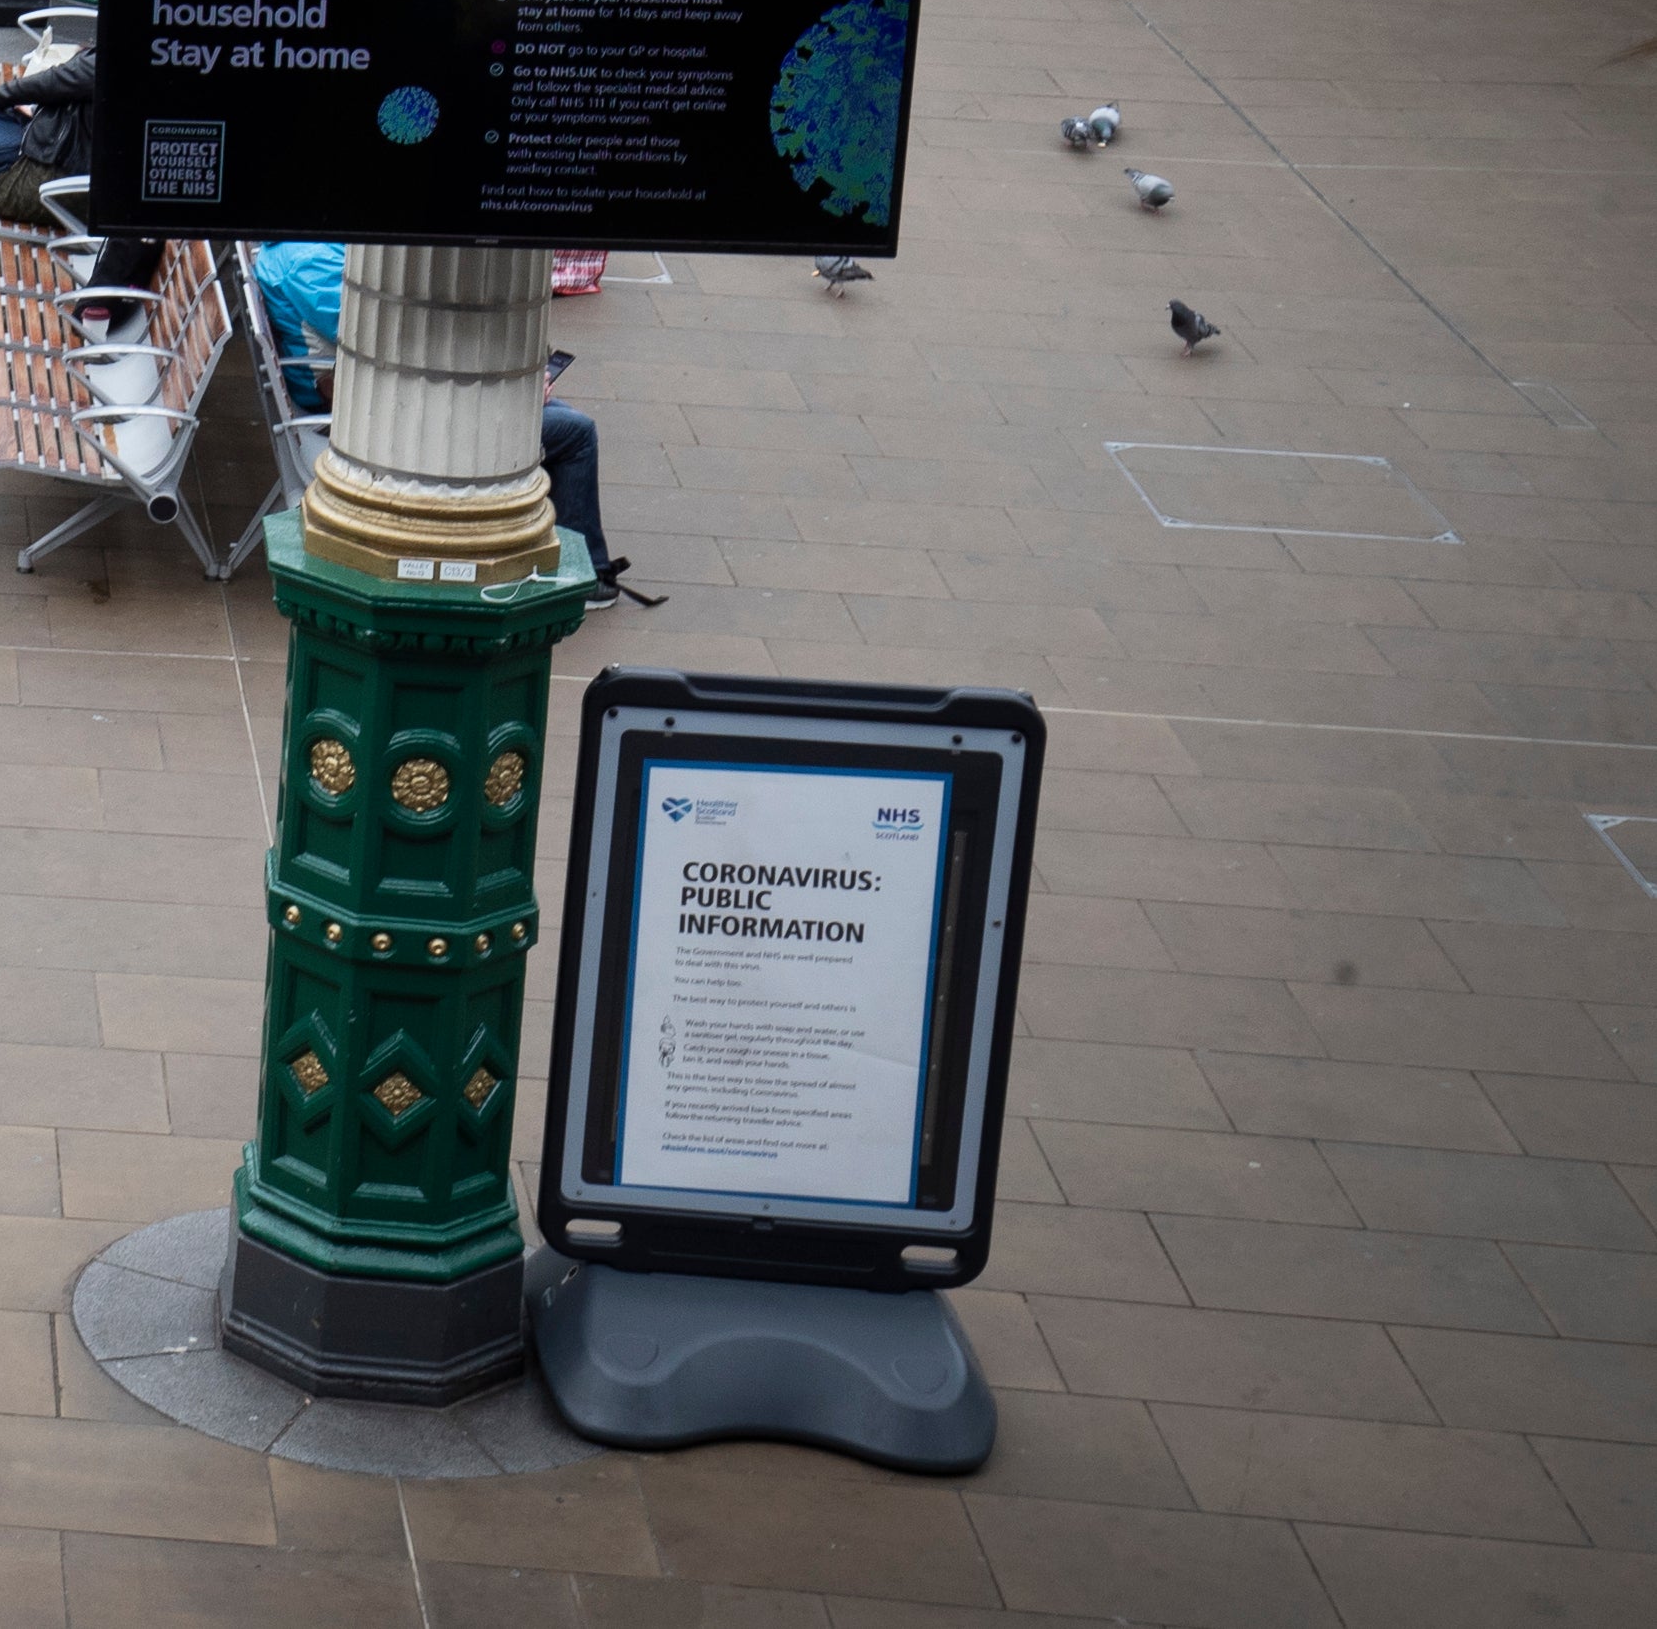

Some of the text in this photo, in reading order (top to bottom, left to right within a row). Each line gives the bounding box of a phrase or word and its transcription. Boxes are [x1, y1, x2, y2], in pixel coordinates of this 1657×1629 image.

[150, 37, 371, 75] Stay at home
[151, 126, 218, 136] CORONAVIRUS
[150, 142, 219, 156] PROTECT
[150, 156, 217, 168] YOURSELF
[149, 168, 215, 182] OTHERS &
[149, 182, 215, 196] THE NHS
[877, 807, 921, 823] NHS
[875, 832, 919, 842] SCOTLAND
[682, 862, 882, 892] CORONAVIRUS:
[681, 887, 772, 910] PUBLIC
[679, 914, 865, 943] INFORMATION
